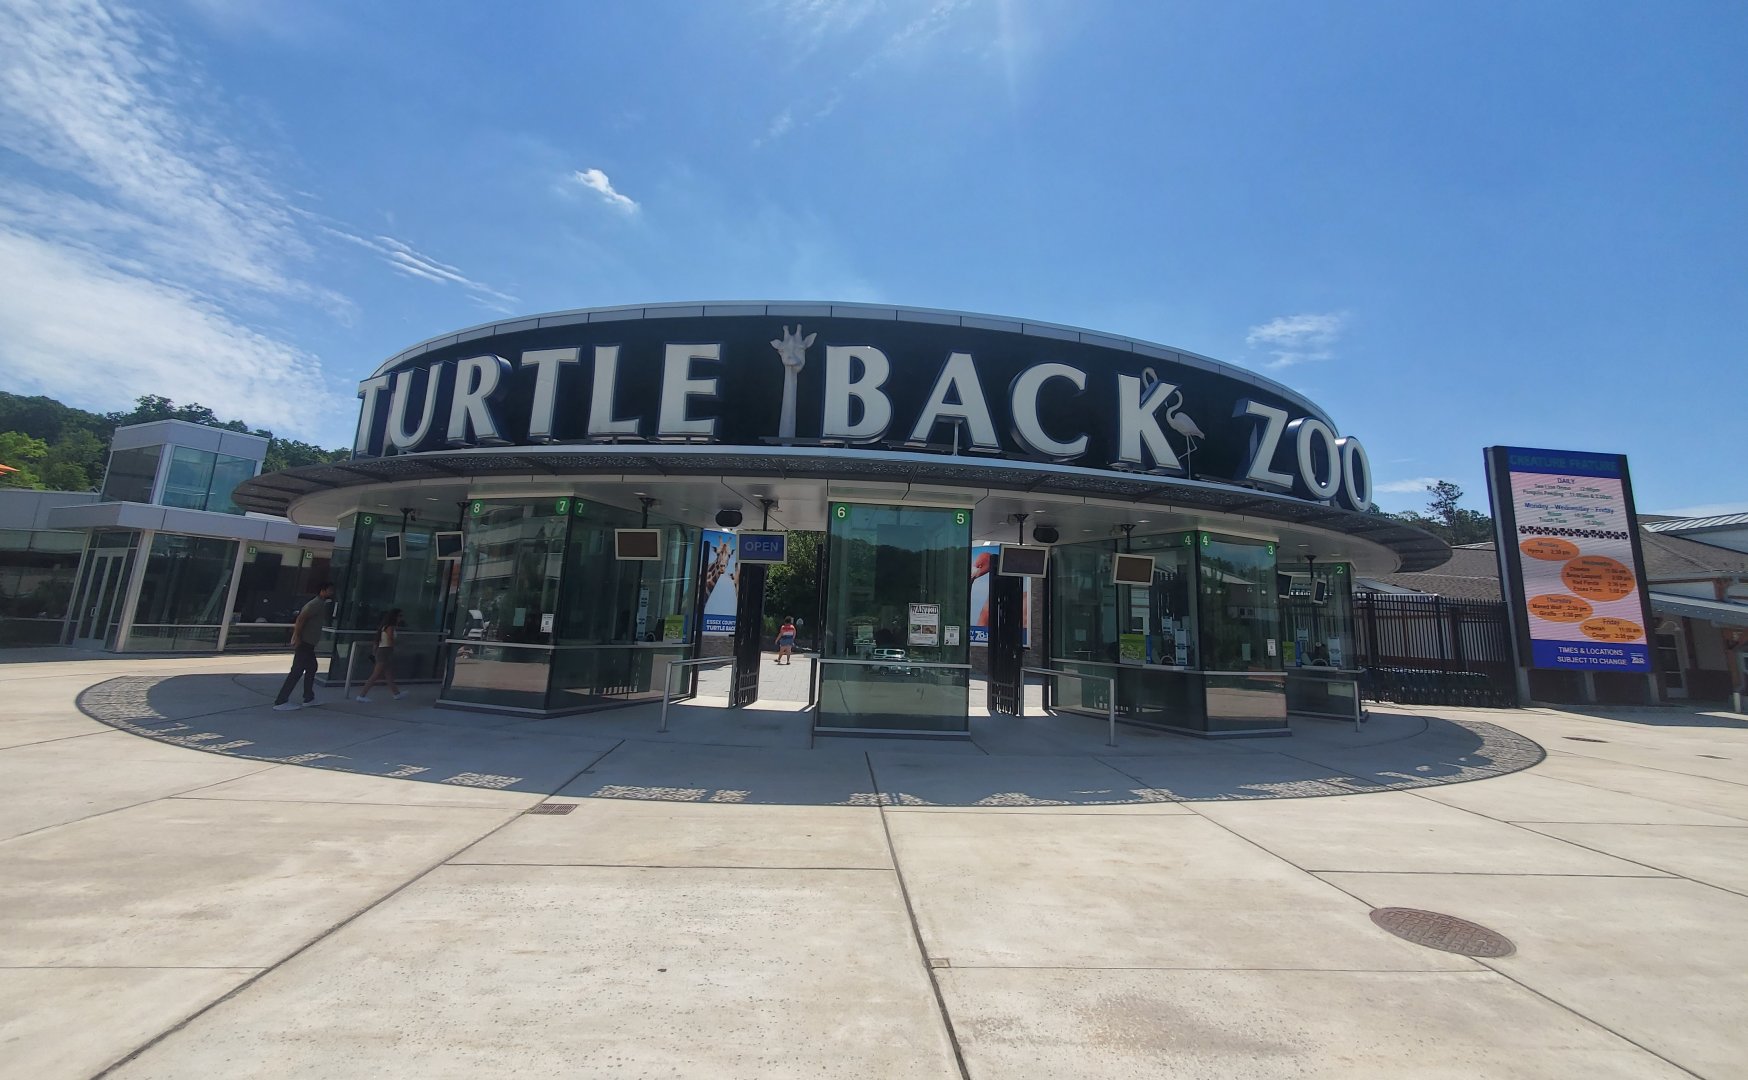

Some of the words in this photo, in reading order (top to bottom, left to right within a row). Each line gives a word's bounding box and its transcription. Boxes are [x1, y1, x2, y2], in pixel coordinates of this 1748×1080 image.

[357, 342, 728, 457] TURTLE
[821, 344, 1184, 473] BACK
[1240, 399, 1373, 512] ZOO
[473, 502, 480, 513] 8
[559, 501, 566, 512] 7
[578, 503, 584, 513] 7
[837, 506, 846, 518] 6
[1554, 504, 1590, 512] Wednesday
[364, 516, 372, 524] 9
[957, 514, 964, 524] 5
[1184, 535, 1191, 545] 4
[1202, 536, 1208, 545] 4
[1268, 545, 1274, 554] 3
[744, 541, 779, 551] OPEN
